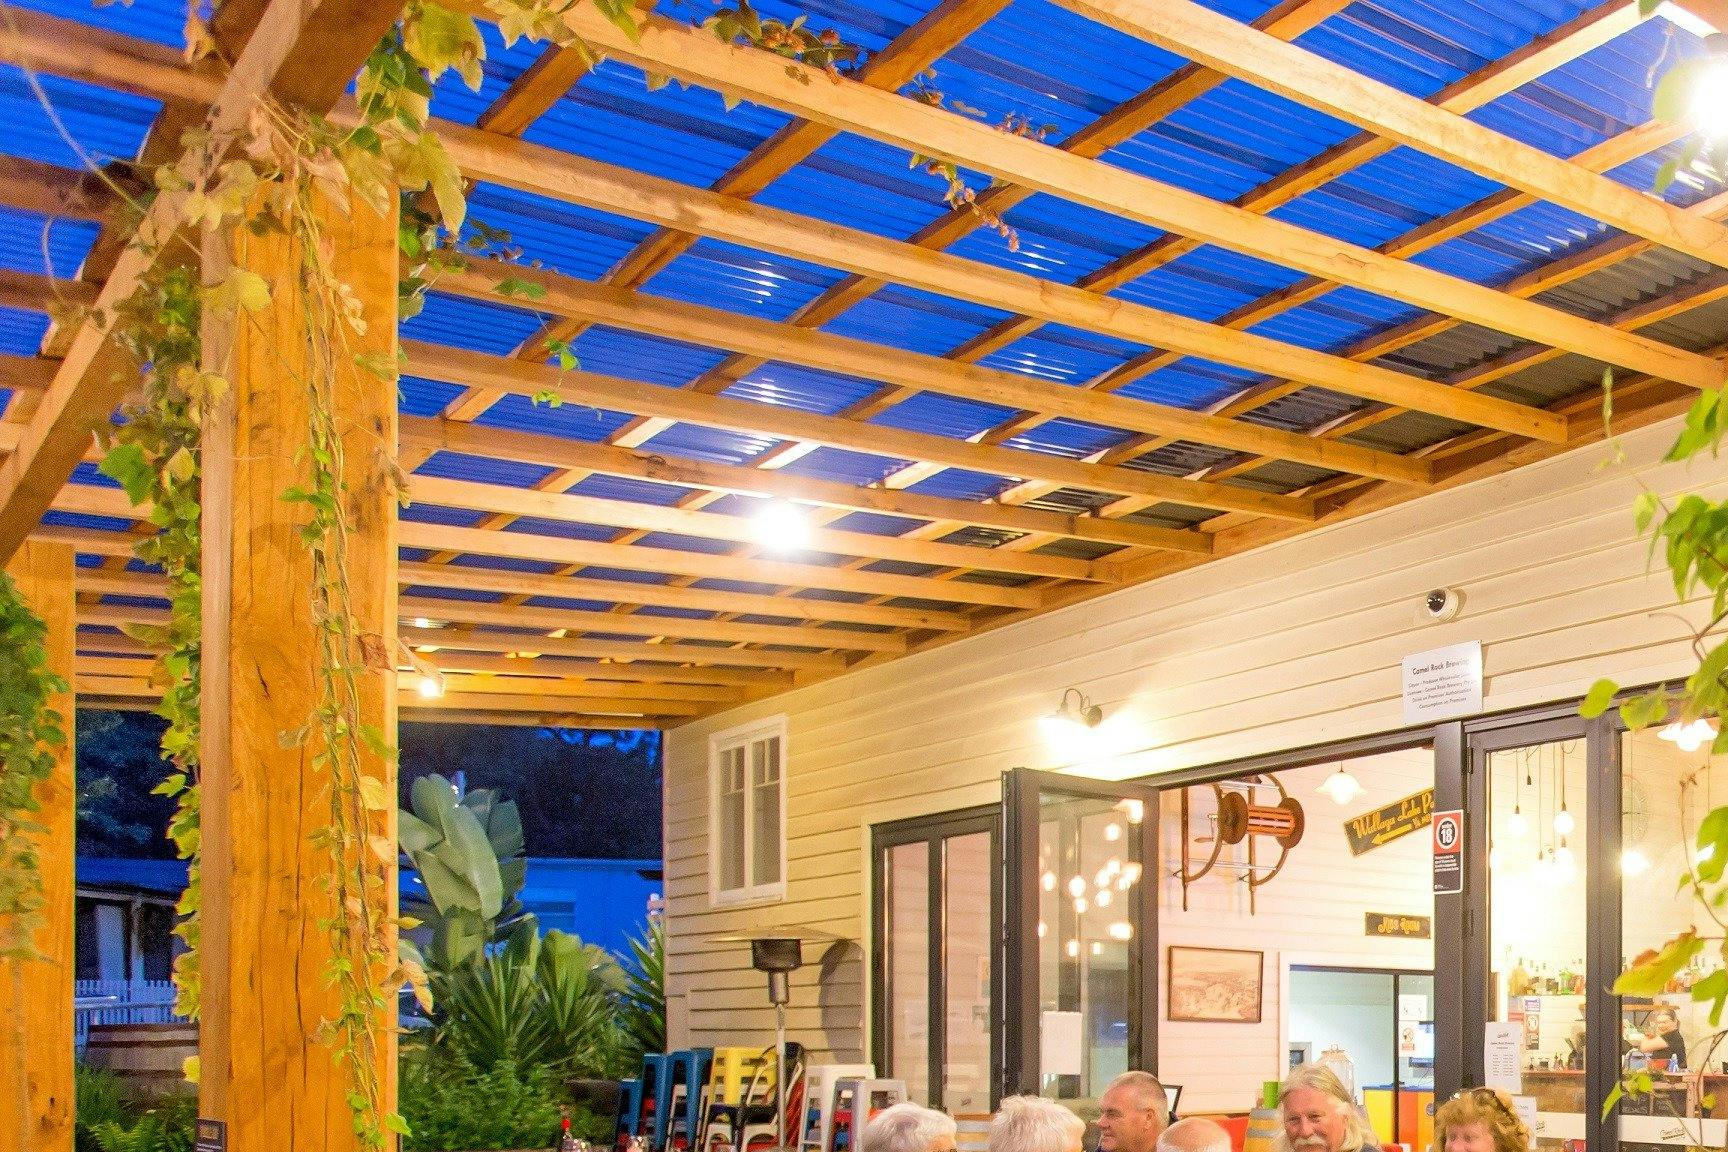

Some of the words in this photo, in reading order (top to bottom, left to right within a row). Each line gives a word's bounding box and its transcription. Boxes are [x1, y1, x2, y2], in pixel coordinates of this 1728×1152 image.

[1412, 665, 1430, 675] Camel
[1430, 662, 1445, 671] Rock
[1440, 828, 1453, 843] 18
